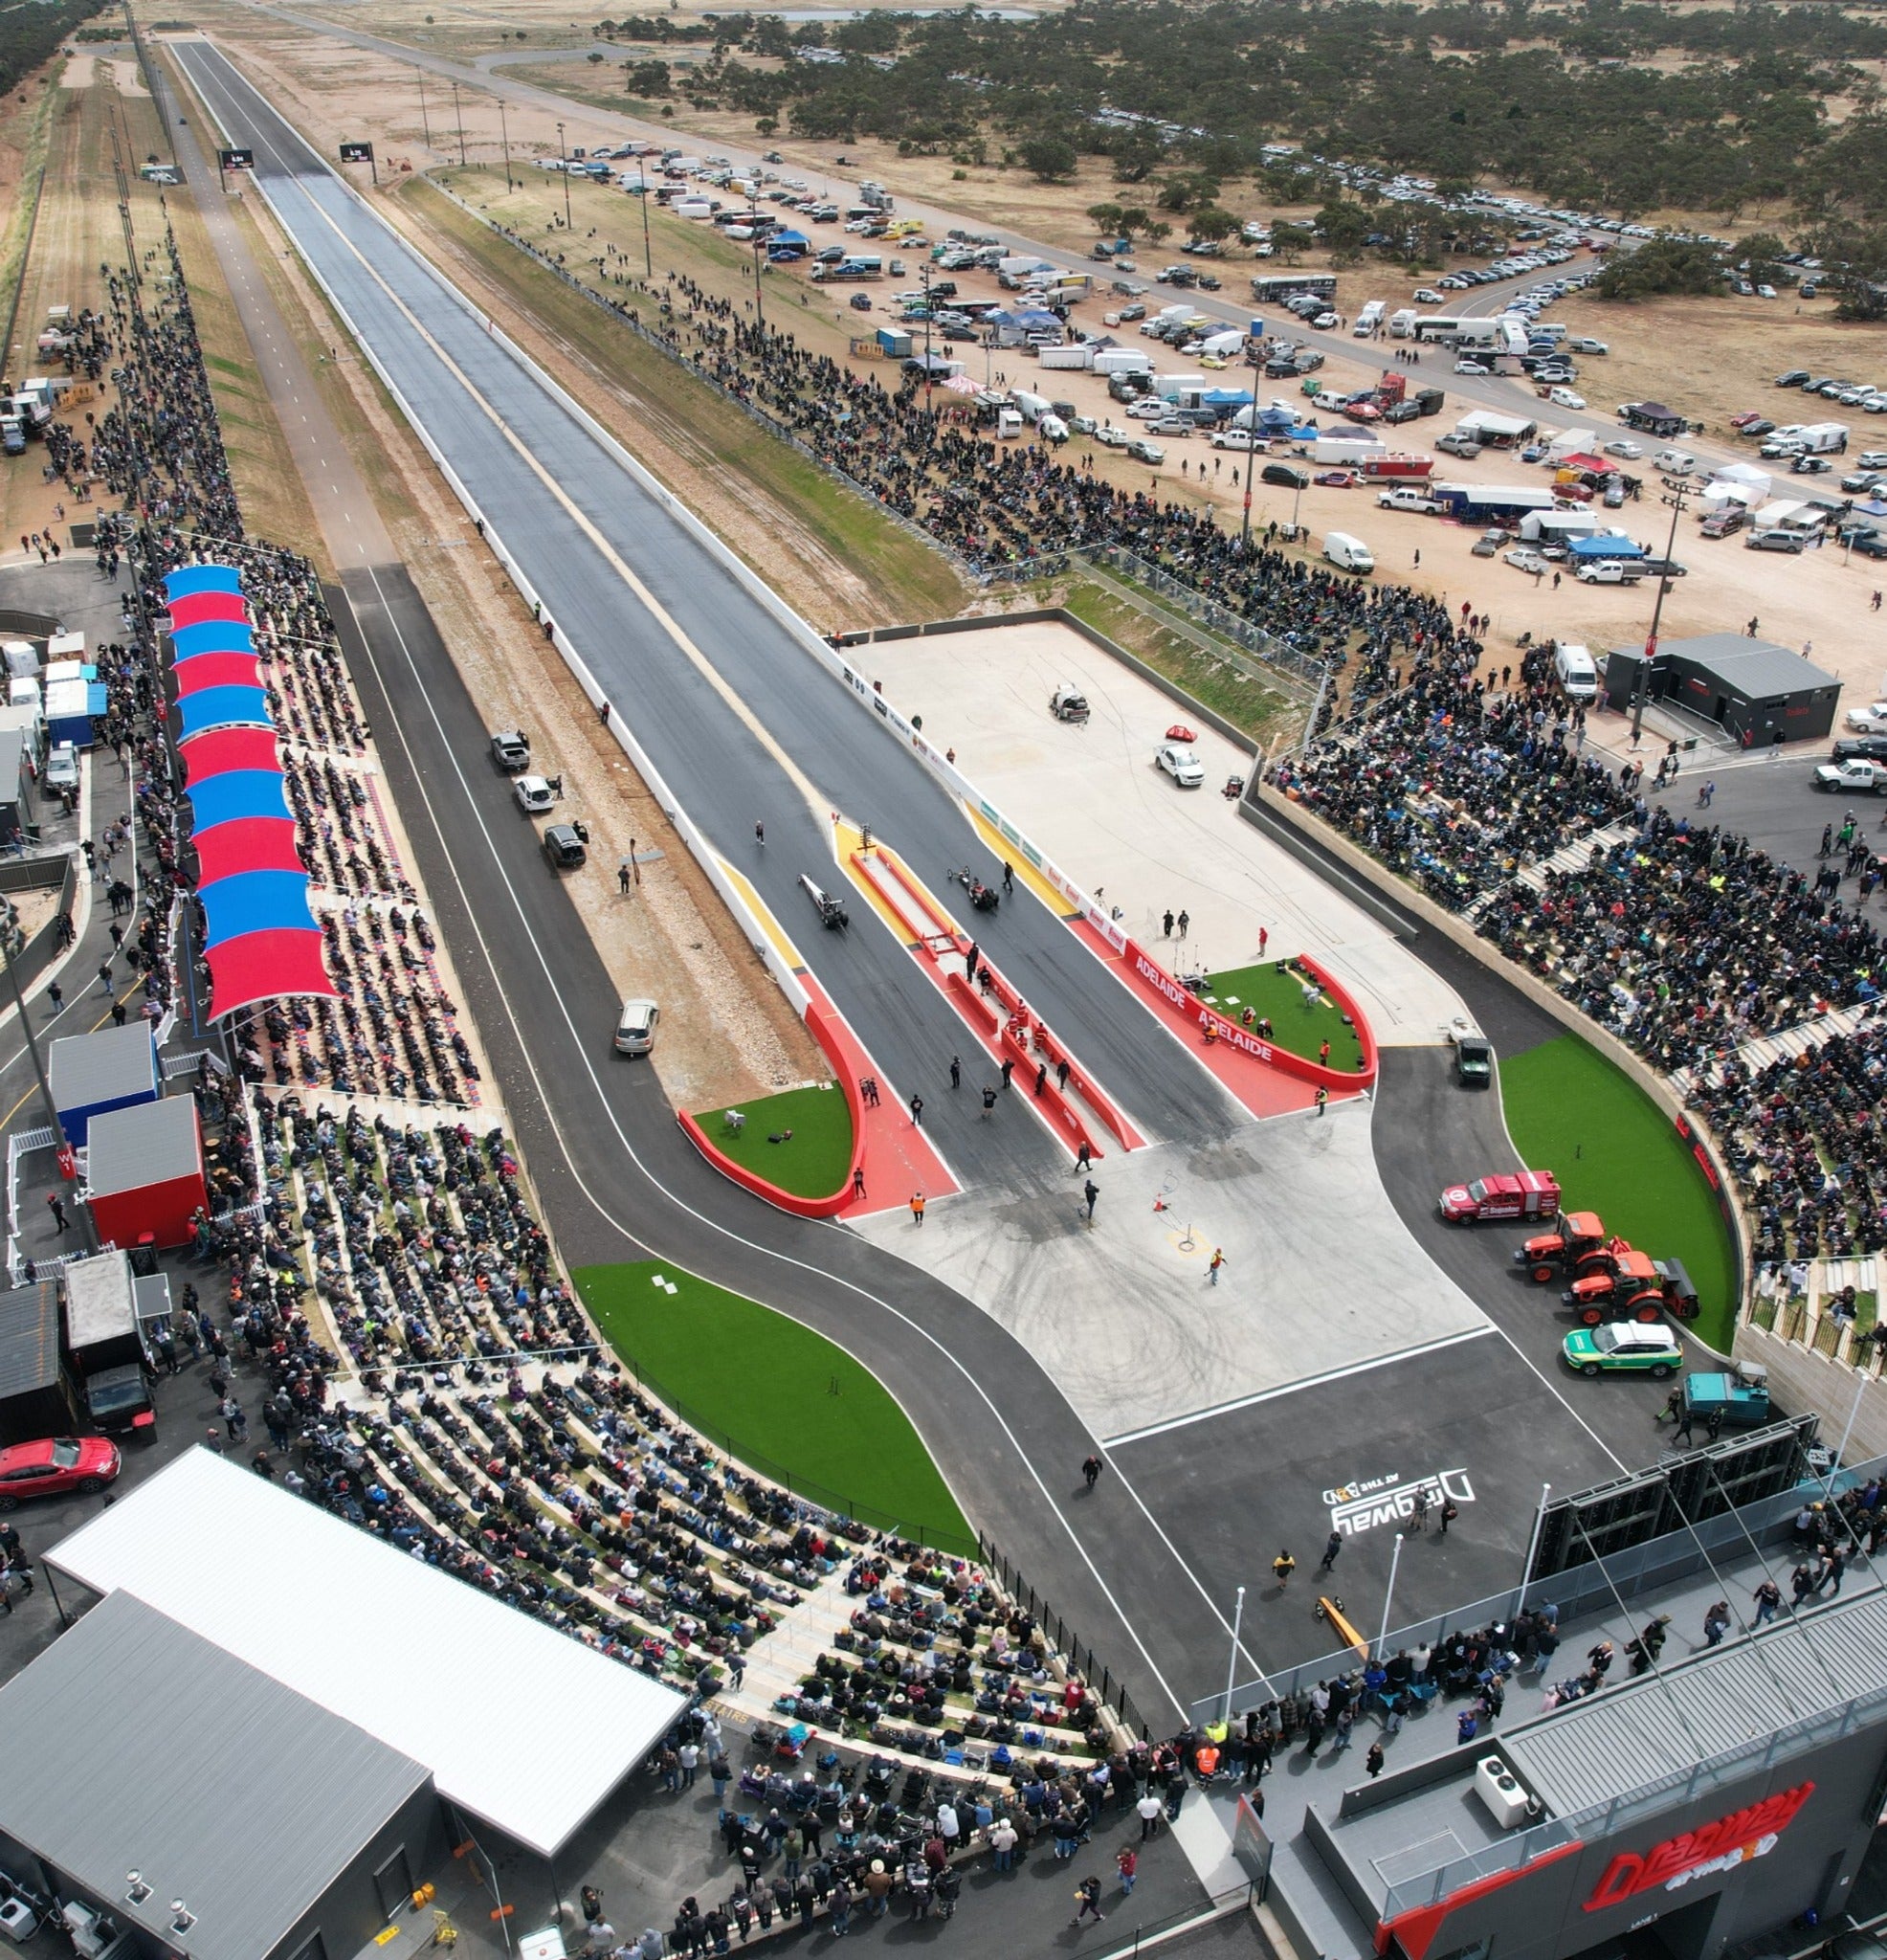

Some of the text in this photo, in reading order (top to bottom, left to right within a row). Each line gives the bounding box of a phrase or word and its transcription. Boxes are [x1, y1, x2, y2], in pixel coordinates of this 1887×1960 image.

[1136, 955, 1186, 1011] ADELAIDE
[57, 1154, 70, 1163] W
[1360, 1477, 1385, 1492] THE
[1385, 1472, 1399, 1483] AT
[1582, 1780, 1817, 1913] Dragway
